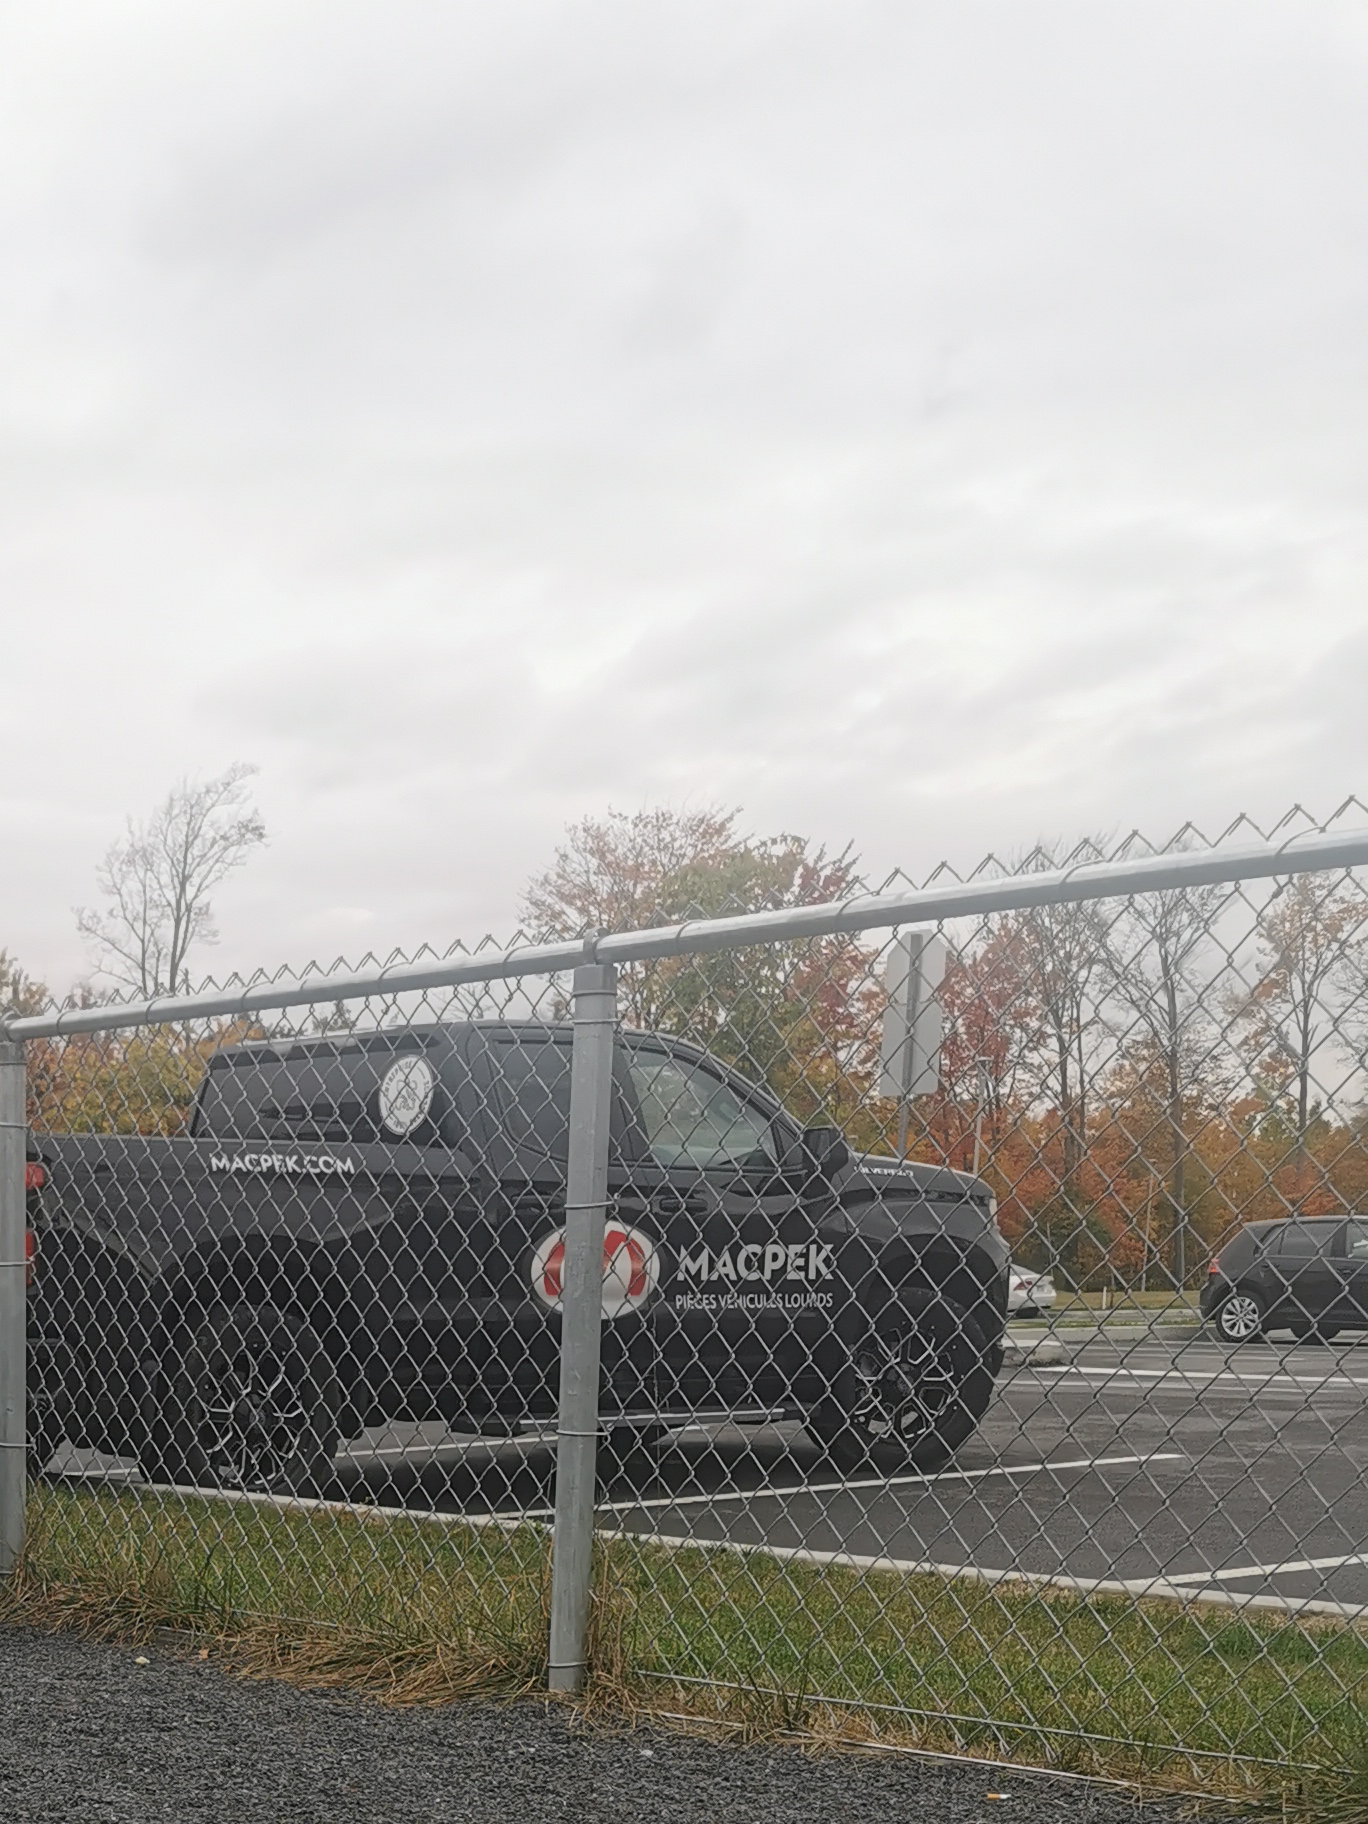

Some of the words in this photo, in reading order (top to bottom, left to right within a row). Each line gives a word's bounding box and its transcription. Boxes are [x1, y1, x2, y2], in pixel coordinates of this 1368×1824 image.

[209, 1153, 355, 1174] MACPEK.COM
[676, 1243, 835, 1281] MACPEK
[785, 1292, 833, 1308] LOURDS
